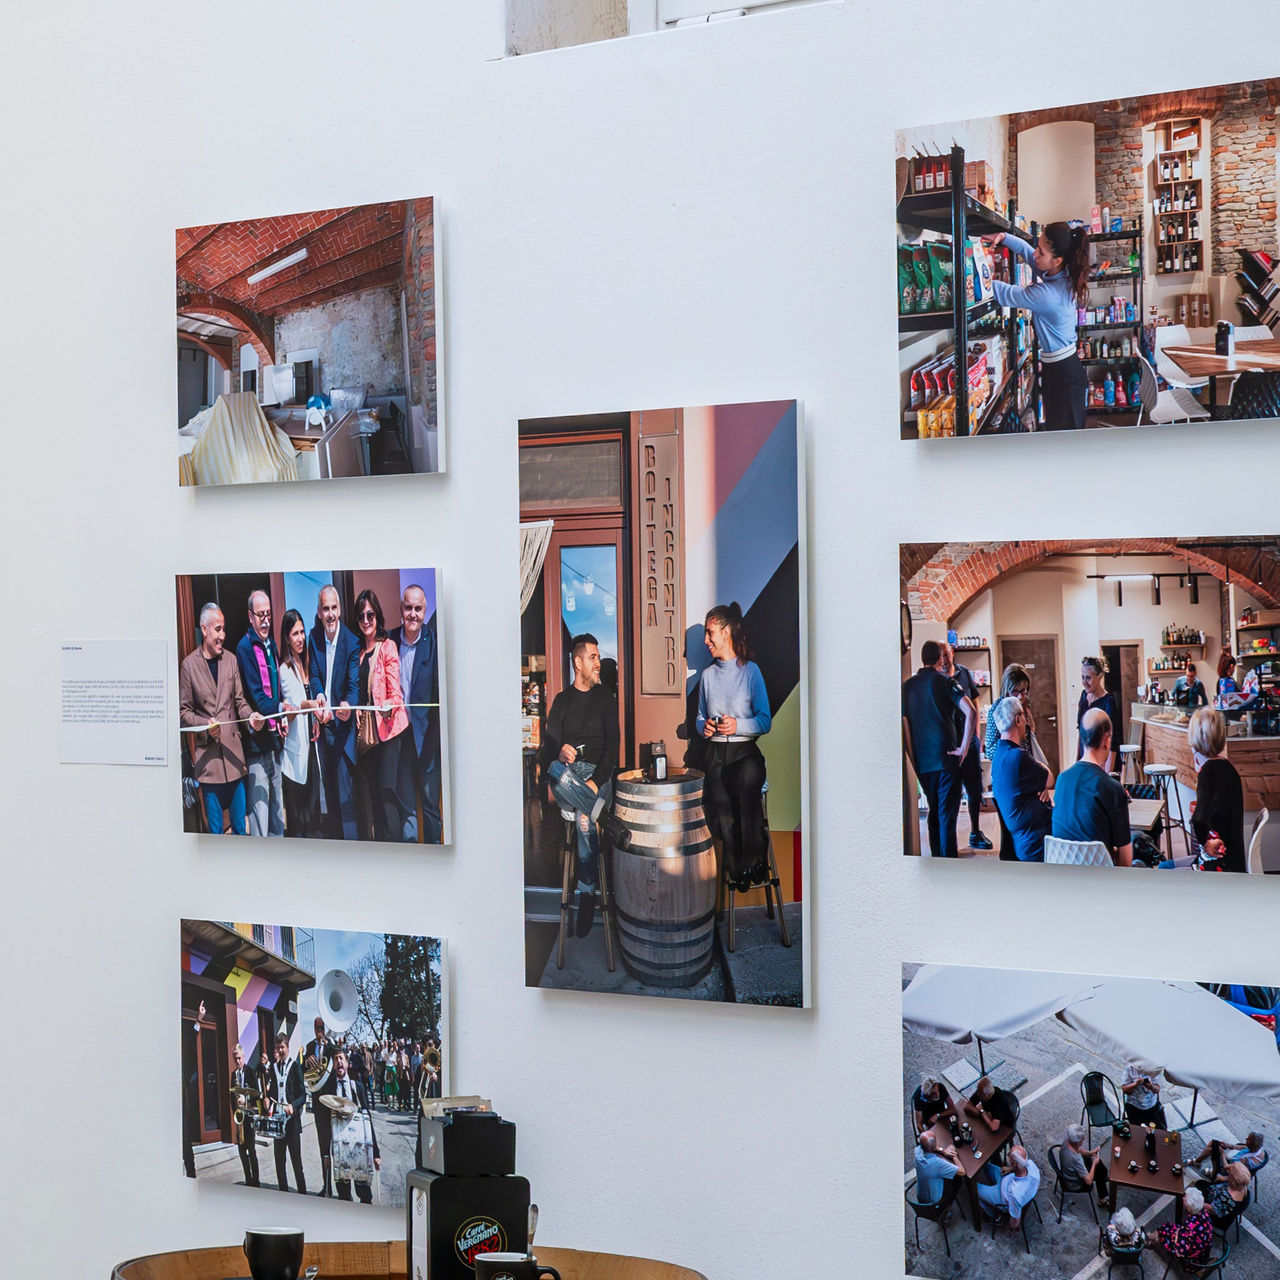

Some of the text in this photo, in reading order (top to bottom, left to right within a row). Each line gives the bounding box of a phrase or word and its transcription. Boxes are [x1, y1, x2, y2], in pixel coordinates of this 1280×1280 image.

[644, 445, 658, 627] BOTTEGA
[663, 477, 676, 687] INCONTRO
[457, 1225, 499, 1252] VERGNANO
